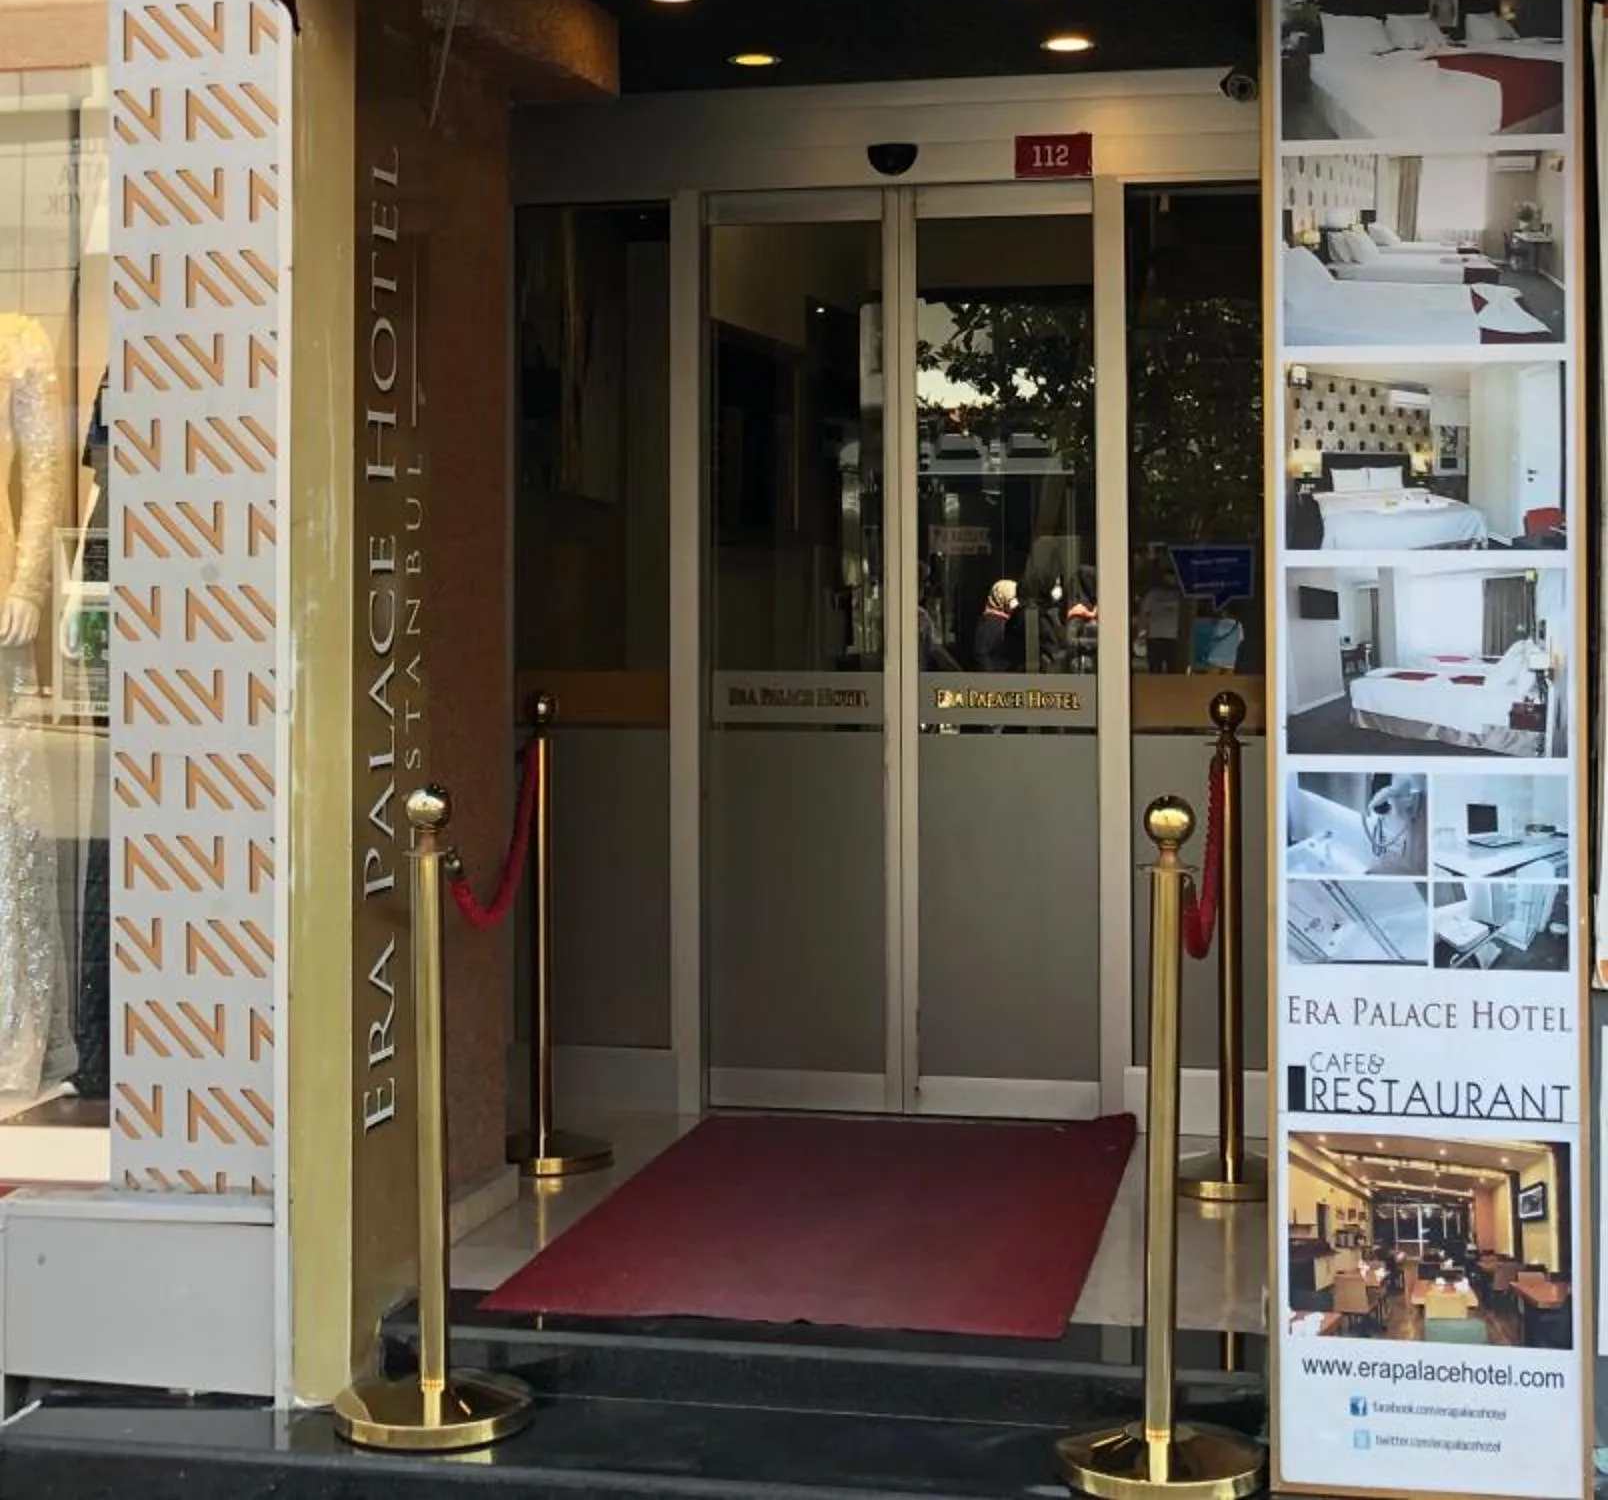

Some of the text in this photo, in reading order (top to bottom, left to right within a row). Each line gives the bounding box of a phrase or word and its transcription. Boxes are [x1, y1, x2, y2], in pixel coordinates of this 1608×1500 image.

[1032, 144, 1070, 167] 112
[363, 147, 398, 1135] ERA PALACE HOTEL
[404, 453, 423, 795] STANBUL
[936, 688, 1080, 710] ERA PALACE HOTEL
[1288, 996, 1572, 1033] ERA PALACE HOTEL
[1310, 1052, 1385, 1075] CAFE&
[1311, 1077, 1571, 1122] RESTAURANT
[1301, 1356, 1566, 1389] www.erapalacehotel.com
